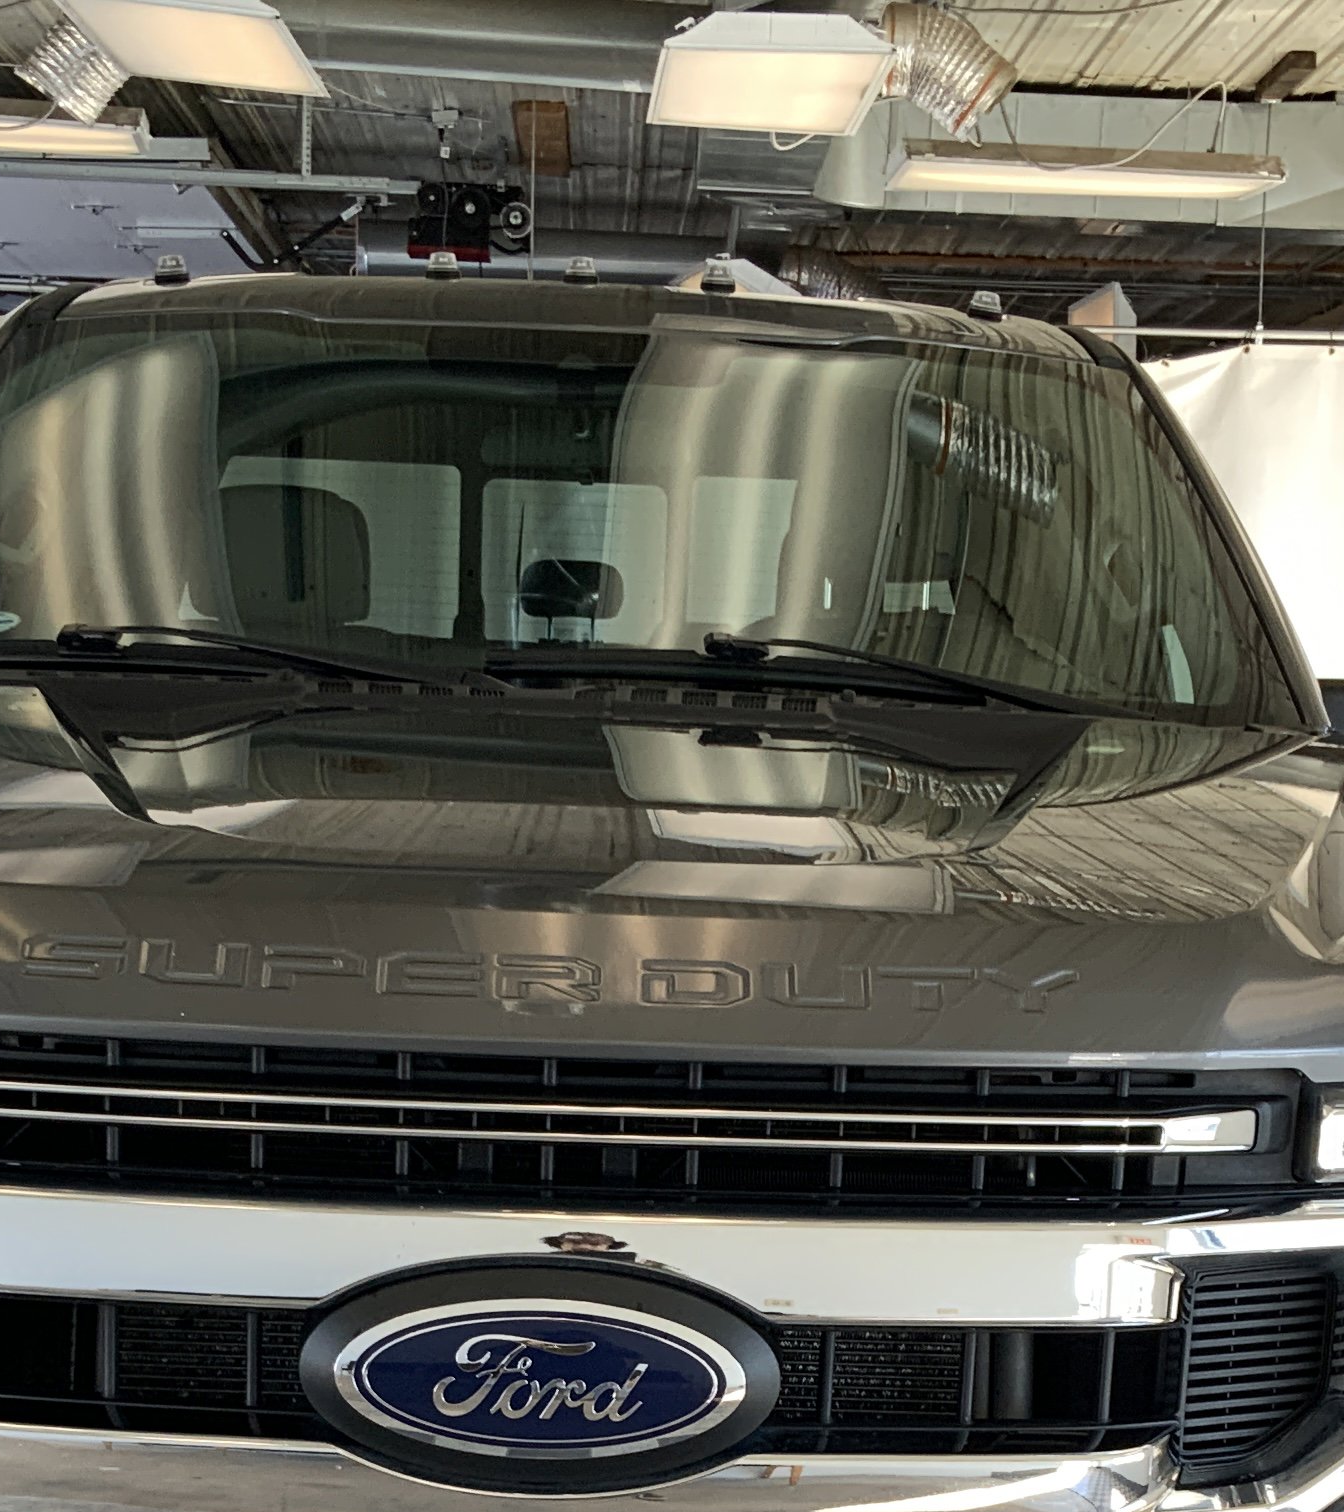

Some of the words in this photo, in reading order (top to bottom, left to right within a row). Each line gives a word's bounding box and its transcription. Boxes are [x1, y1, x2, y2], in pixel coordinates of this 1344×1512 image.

[21, 934, 602, 1000] SUPER
[639, 958, 1081, 1013] DUTY
[432, 1333, 649, 1422] Ford
